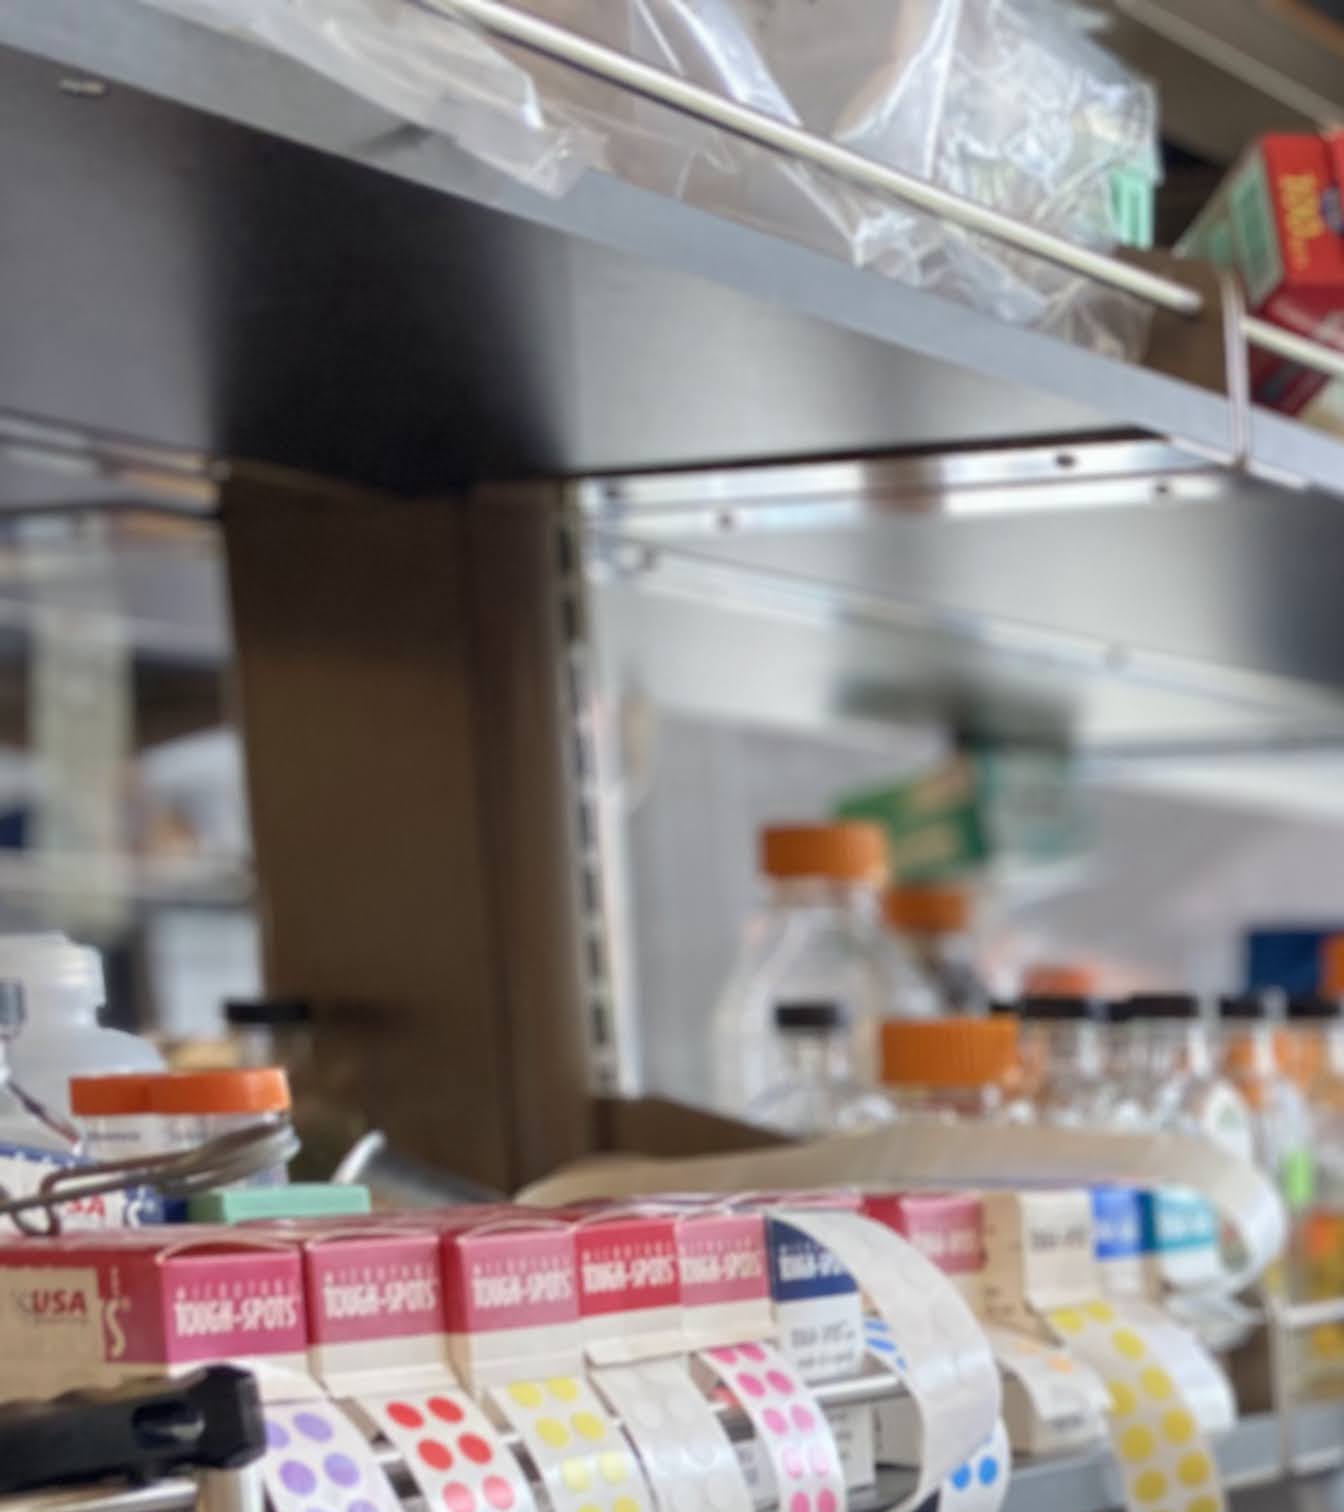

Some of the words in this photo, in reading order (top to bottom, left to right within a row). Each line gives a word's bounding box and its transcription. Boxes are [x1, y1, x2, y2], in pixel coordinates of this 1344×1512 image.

[472, 1271, 573, 1309] TOUGH-SPOTS
[581, 1253, 677, 1294] TOUGH-SPOTS
[32, 1290, 87, 1314] USA
[174, 1296, 298, 1337] TOUGH-SPOTS
[323, 1278, 437, 1320] TOUGH-SPOTS
